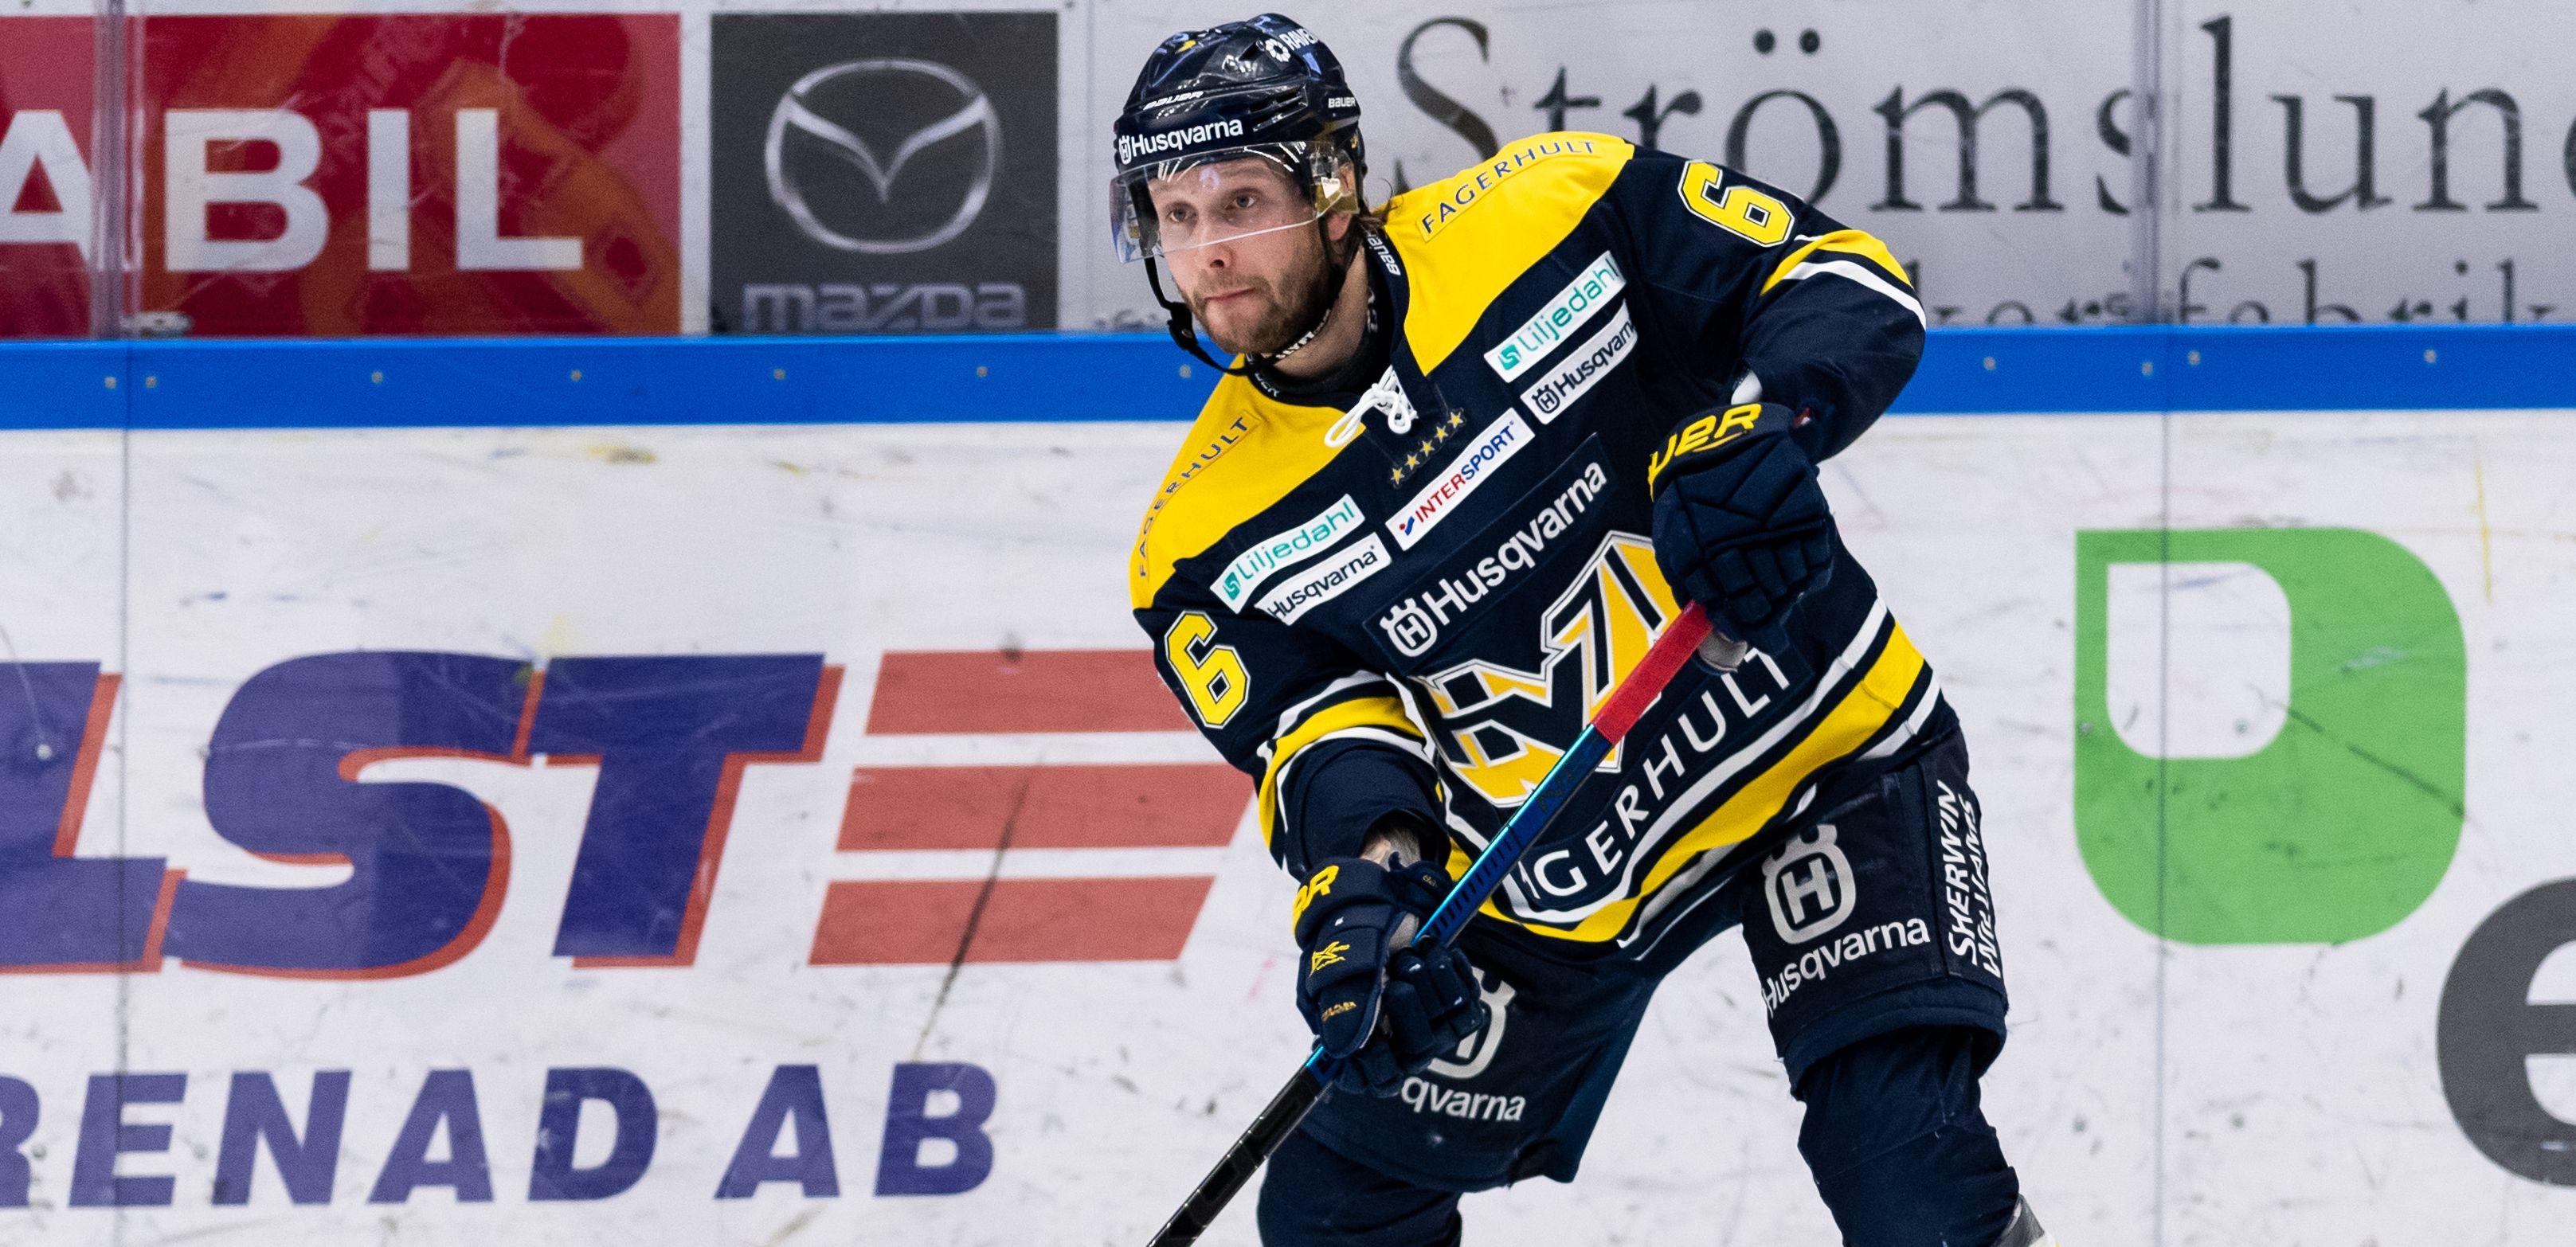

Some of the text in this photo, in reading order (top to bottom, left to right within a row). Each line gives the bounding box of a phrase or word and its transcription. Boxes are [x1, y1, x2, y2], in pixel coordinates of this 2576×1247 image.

[1131, 119, 1243, 158] Husqvarna
[1396, 14, 2576, 213] Strömslun
[1421, 139, 1596, 234] FAGERHULT
[1517, 257, 1620, 352] Liljedahl
[1552, 320, 1636, 397] Husqvarn
[1138, 416, 1248, 577] FAGERHULT
[1415, 424, 1515, 523] INTERSPORT
[1235, 502, 1355, 580] Liljedahl
[1267, 549, 1378, 619] Husqvarna
[1421, 462, 1607, 627] Husqvarna
[1165, 611, 1250, 729] 6
[1517, 647, 1790, 900] GERHULT
[1936, 779, 1978, 967] SHERWIN
[1760, 917, 1931, 1019] Husqvarna
[713, 1061, 997, 1201] AB
[1400, 1075, 1527, 1122] qvarna
